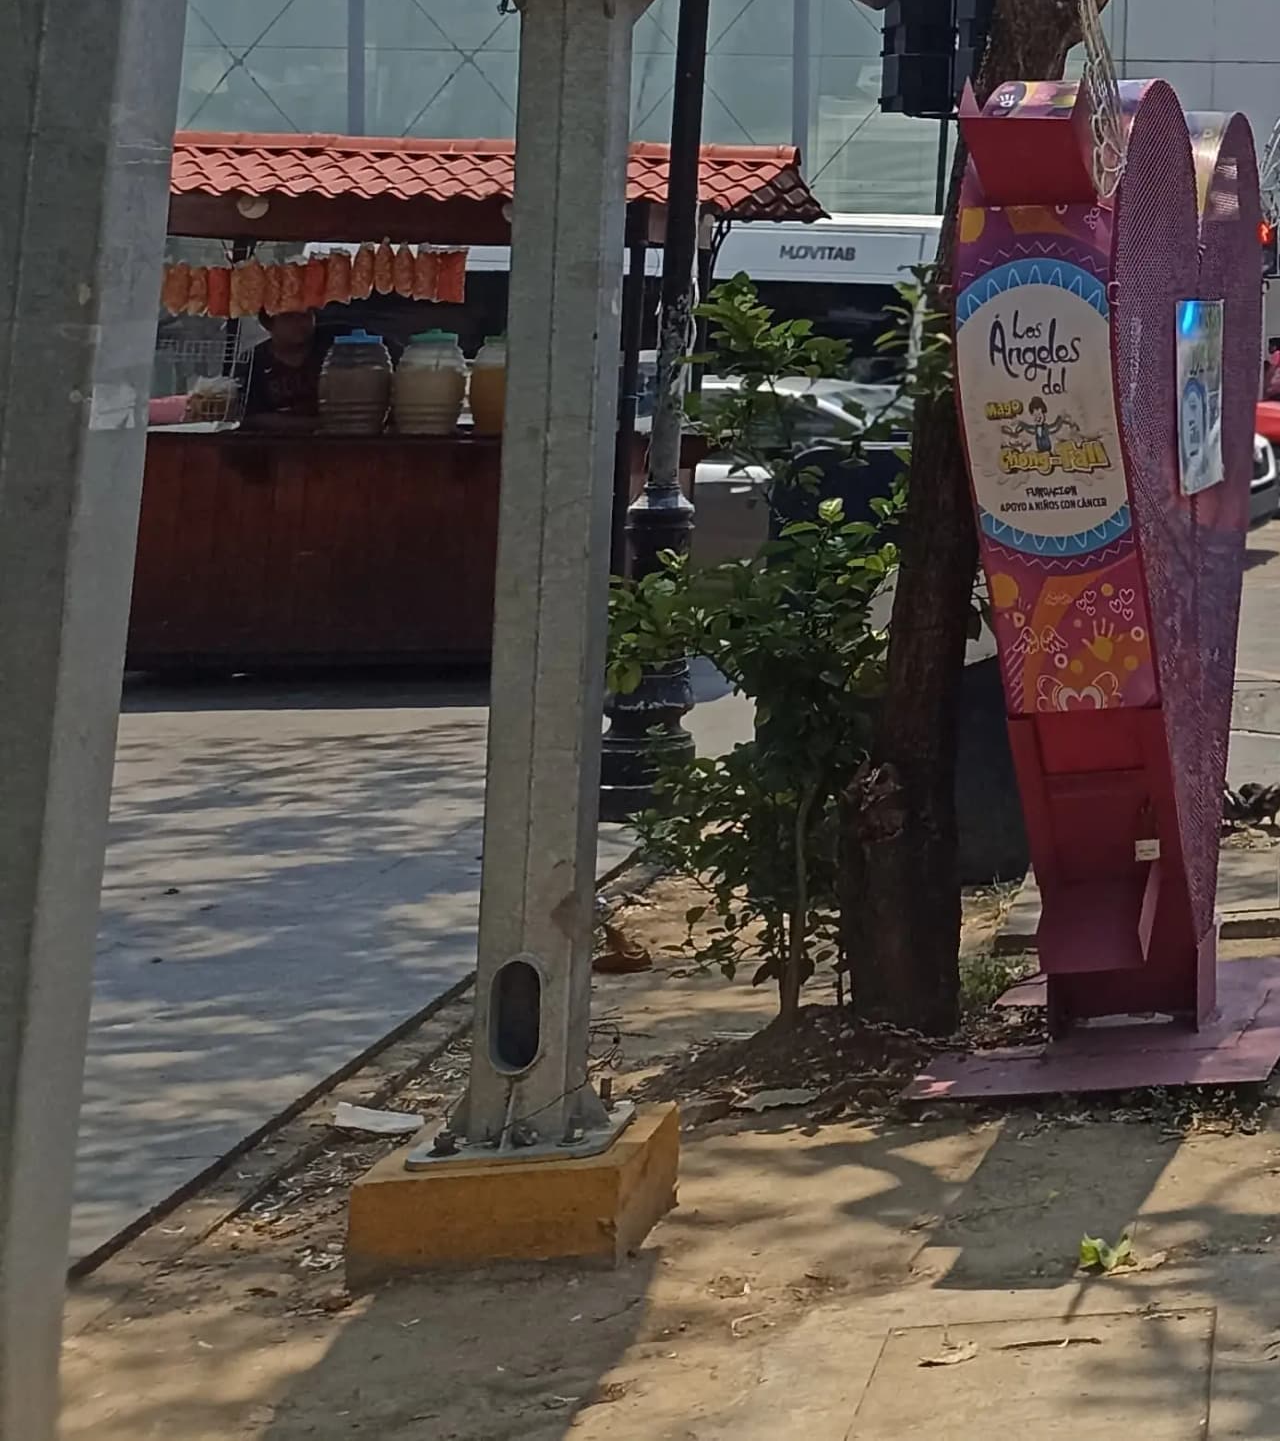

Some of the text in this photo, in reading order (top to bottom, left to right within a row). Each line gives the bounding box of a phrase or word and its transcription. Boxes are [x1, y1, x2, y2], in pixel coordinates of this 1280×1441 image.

[779, 245, 856, 261] MOVITAB
[1012, 310, 1042, 340] Los
[1041, 367, 1067, 395] del
[985, 399, 1023, 420] Mago
[1001, 502, 1027, 512] APOYO
[1029, 503, 1035, 511] A
[1035, 499, 1060, 511] NIÑOS
[1061, 500, 1076, 509] CON
